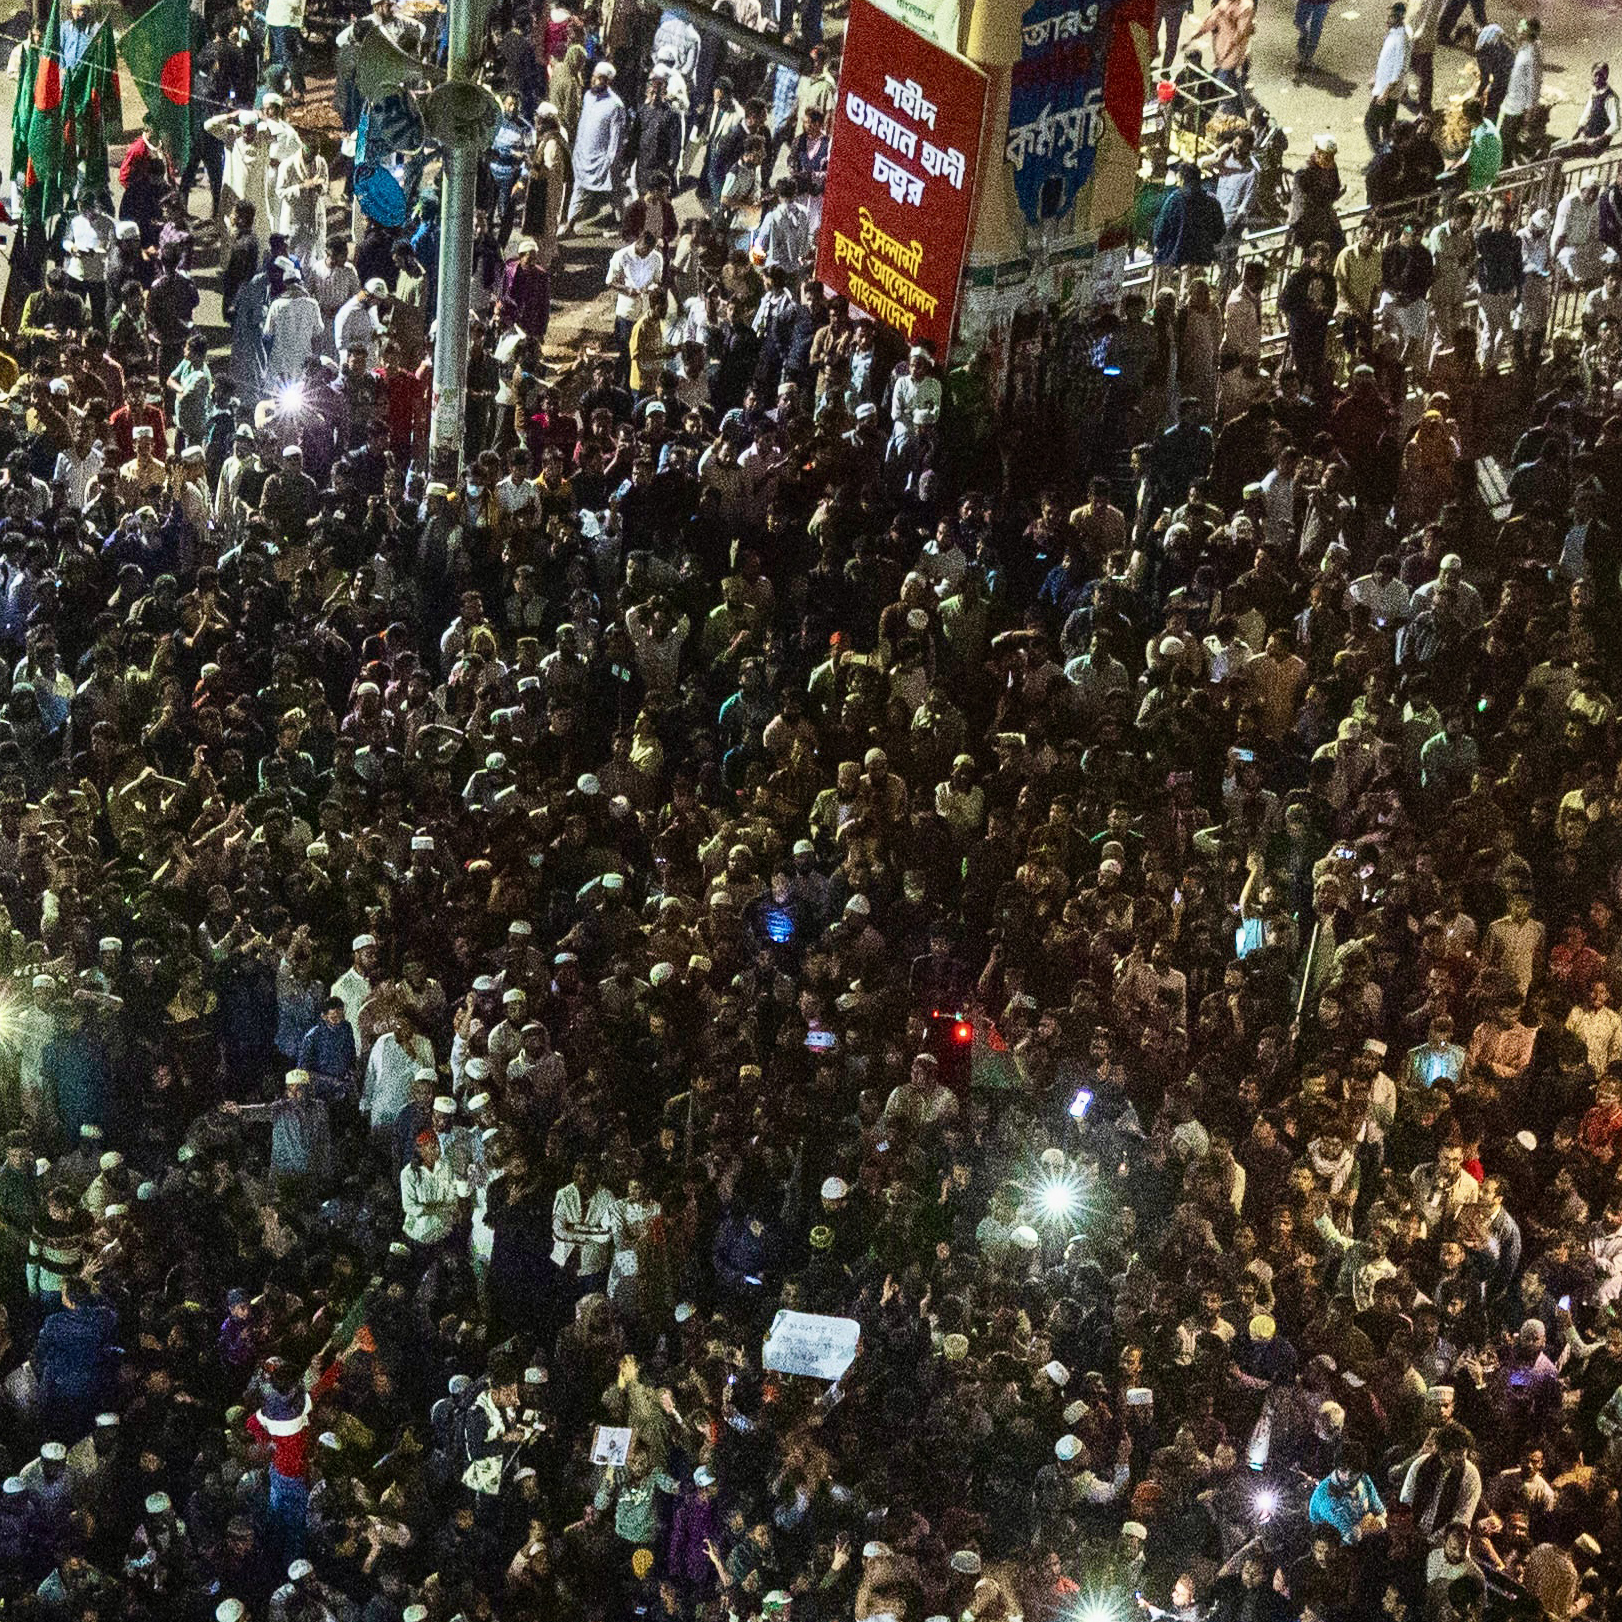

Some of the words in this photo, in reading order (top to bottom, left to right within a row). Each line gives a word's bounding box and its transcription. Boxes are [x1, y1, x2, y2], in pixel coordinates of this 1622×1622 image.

[884, 74, 938, 131] শহীদ
[846, 92, 919, 160] ওসমান
[920, 139, 967, 190] হাদী
[872, 152, 926, 207] চত্বর
[833, 230, 866, 271] ছাত্র
[866, 255, 939, 319] আন্দোলন
[858, 206, 924, 279] ইসলামী
[848, 271, 917, 338] বাংলাদেশ
